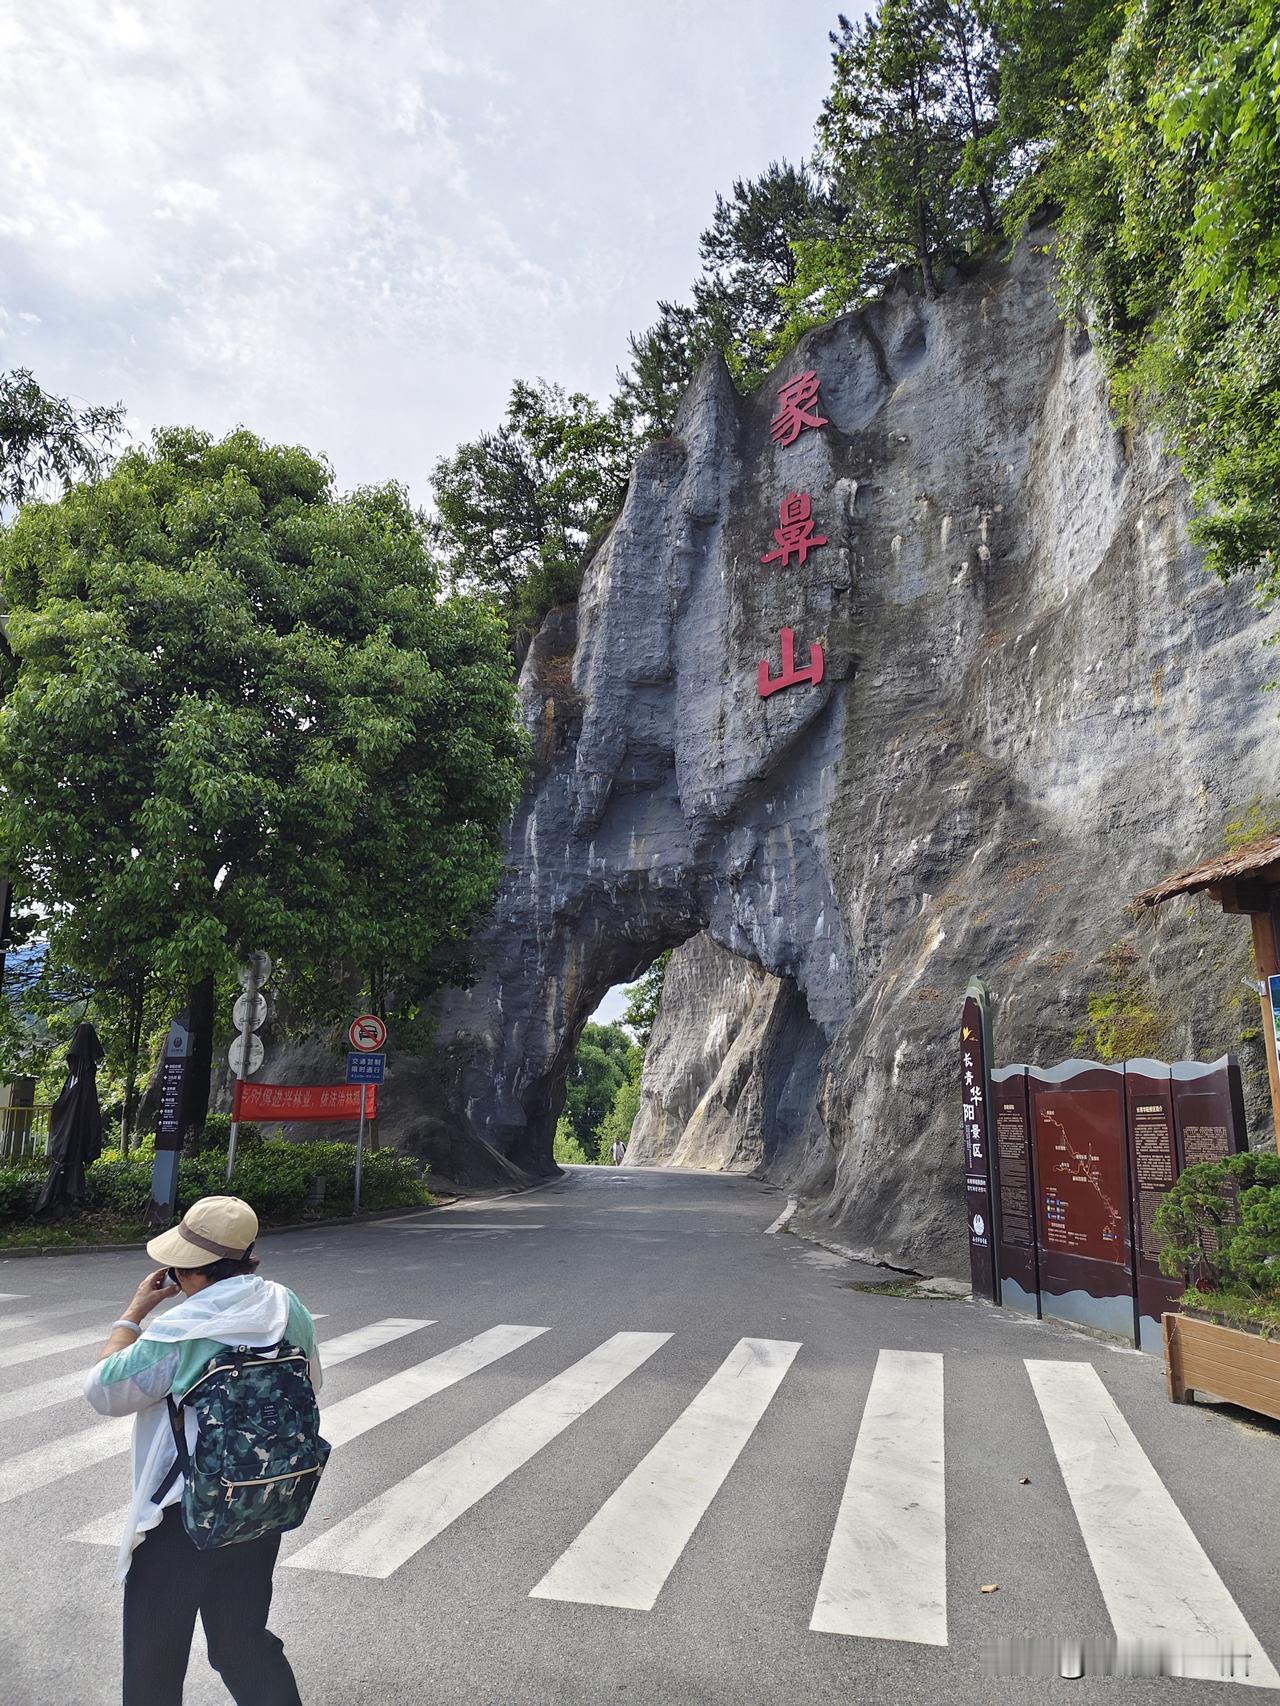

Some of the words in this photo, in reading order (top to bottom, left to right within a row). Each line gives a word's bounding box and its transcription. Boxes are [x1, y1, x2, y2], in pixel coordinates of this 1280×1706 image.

[758, 370, 828, 697] 象鼻山
[963, 1052, 983, 1158] 长青华阳景区
